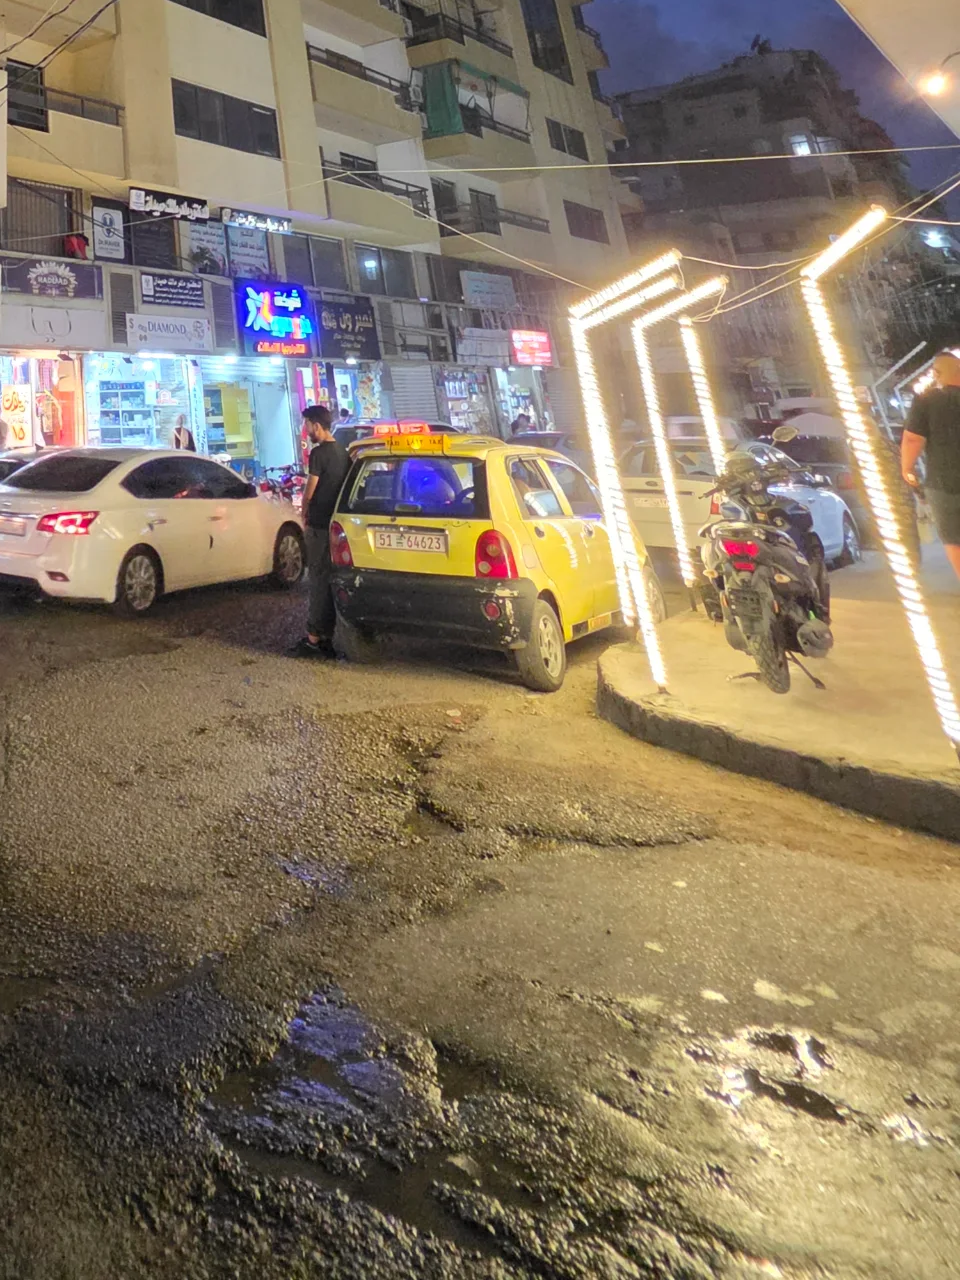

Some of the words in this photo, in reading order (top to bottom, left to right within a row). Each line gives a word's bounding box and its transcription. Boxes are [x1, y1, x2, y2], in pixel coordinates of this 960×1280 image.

[37, 276, 68, 285] HADDAD
[153, 277, 167, 286] حميدان
[186, 280, 202, 289] الدكتور
[147, 321, 187, 334] DIAMOND
[380, 534, 392, 546] 51
[407, 536, 441, 549] 64623
